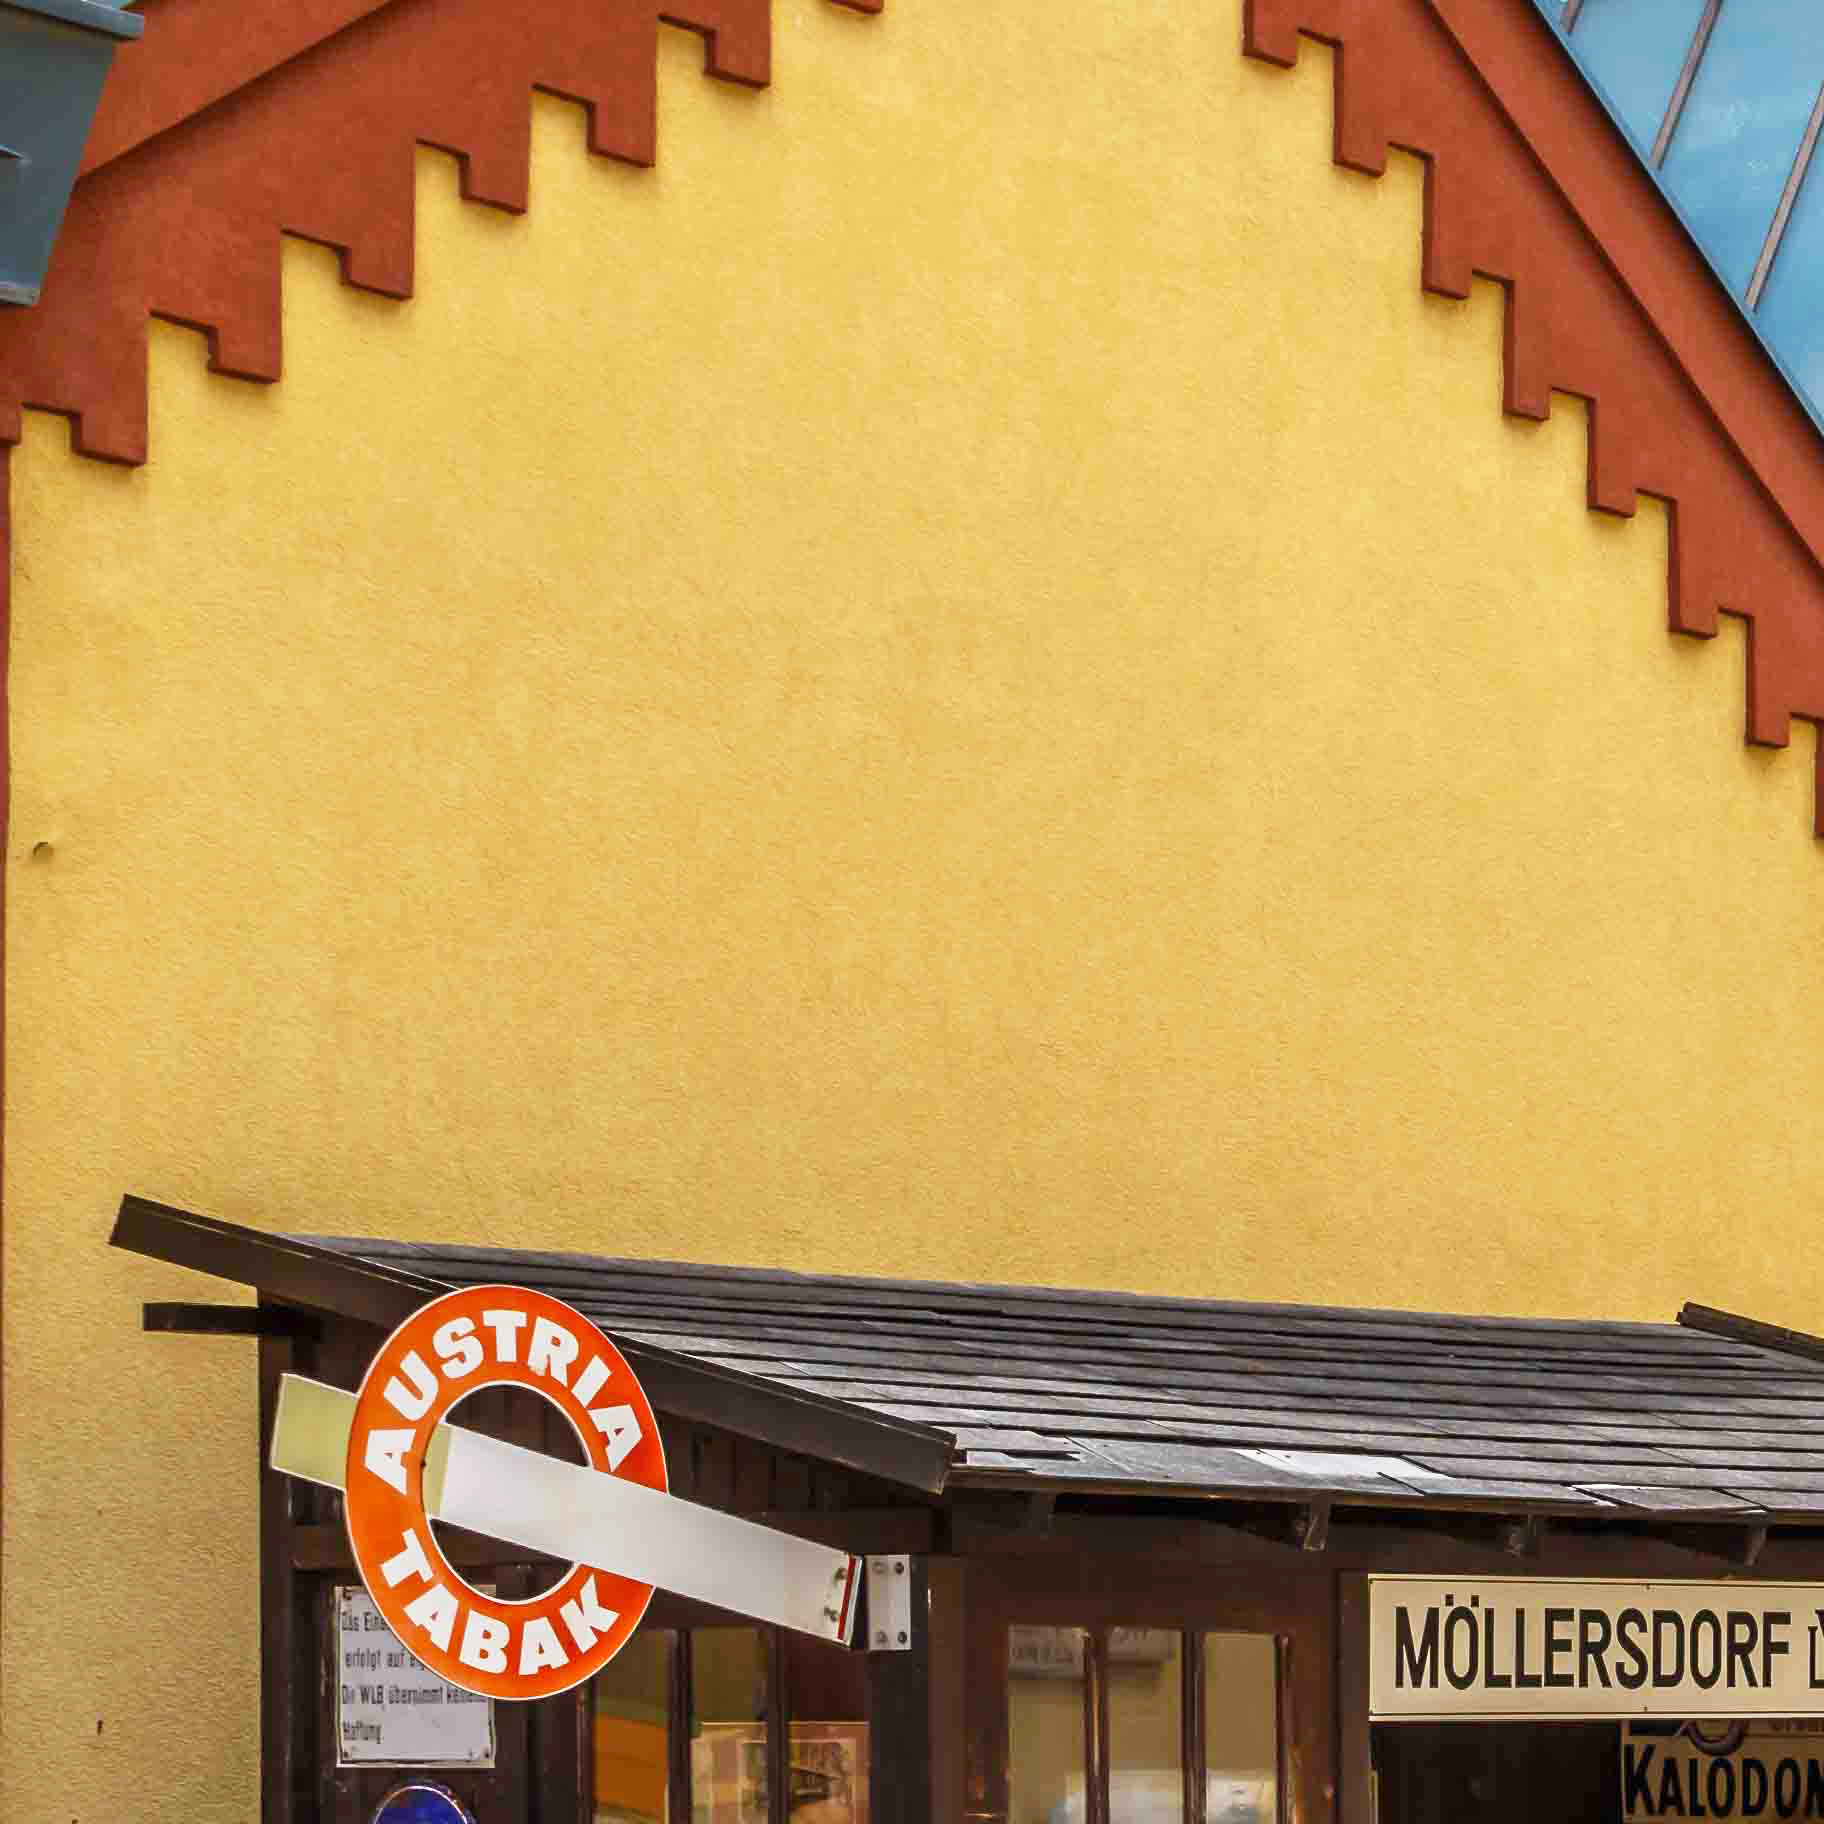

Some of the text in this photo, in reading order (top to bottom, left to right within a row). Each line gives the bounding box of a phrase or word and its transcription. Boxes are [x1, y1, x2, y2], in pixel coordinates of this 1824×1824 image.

[363, 1309, 643, 1496] AUSTRIA
[378, 1527, 620, 1677] TABAK
[1394, 1592, 1792, 1691] MÖLLERSDORF
[360, 1684, 385, 1705] WLB
